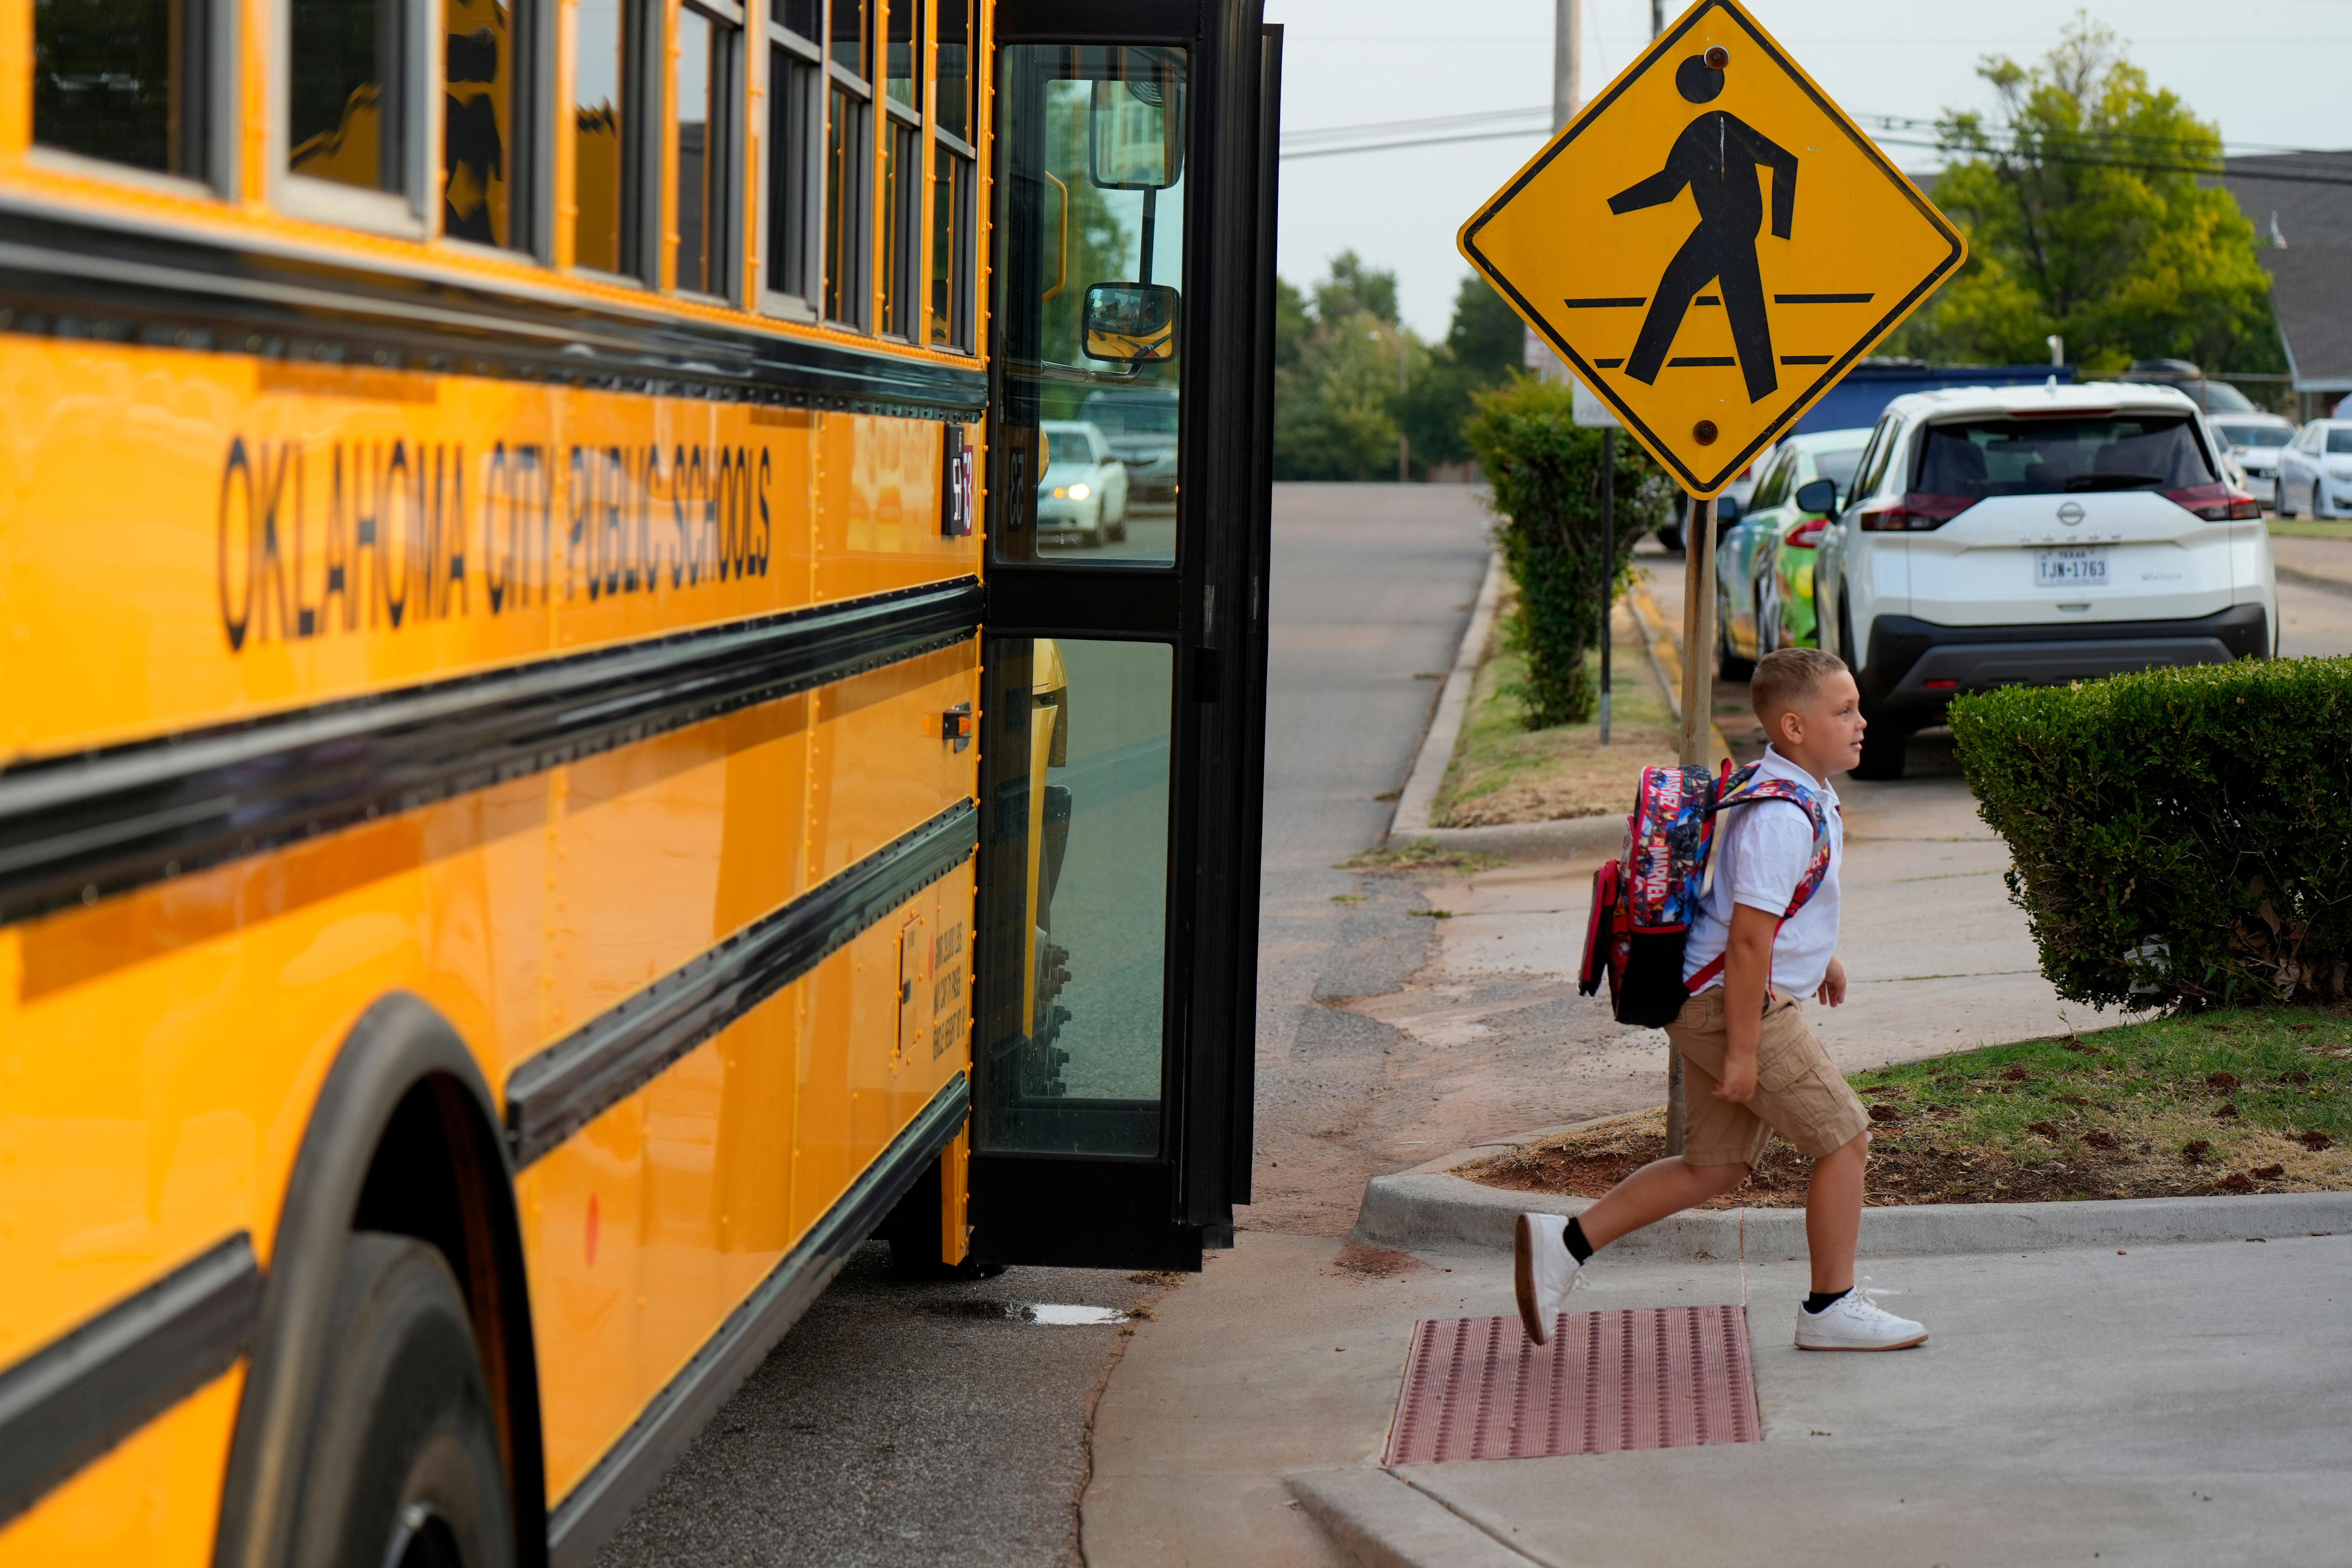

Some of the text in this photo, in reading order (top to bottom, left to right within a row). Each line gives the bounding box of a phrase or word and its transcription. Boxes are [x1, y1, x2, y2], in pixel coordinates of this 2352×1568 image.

[218, 436, 769, 651] OKLAHOMA CITY PUBLIC SCHOOLS
[1647, 847, 1669, 901] MARVEL
[952, 965, 961, 1002] PASS
